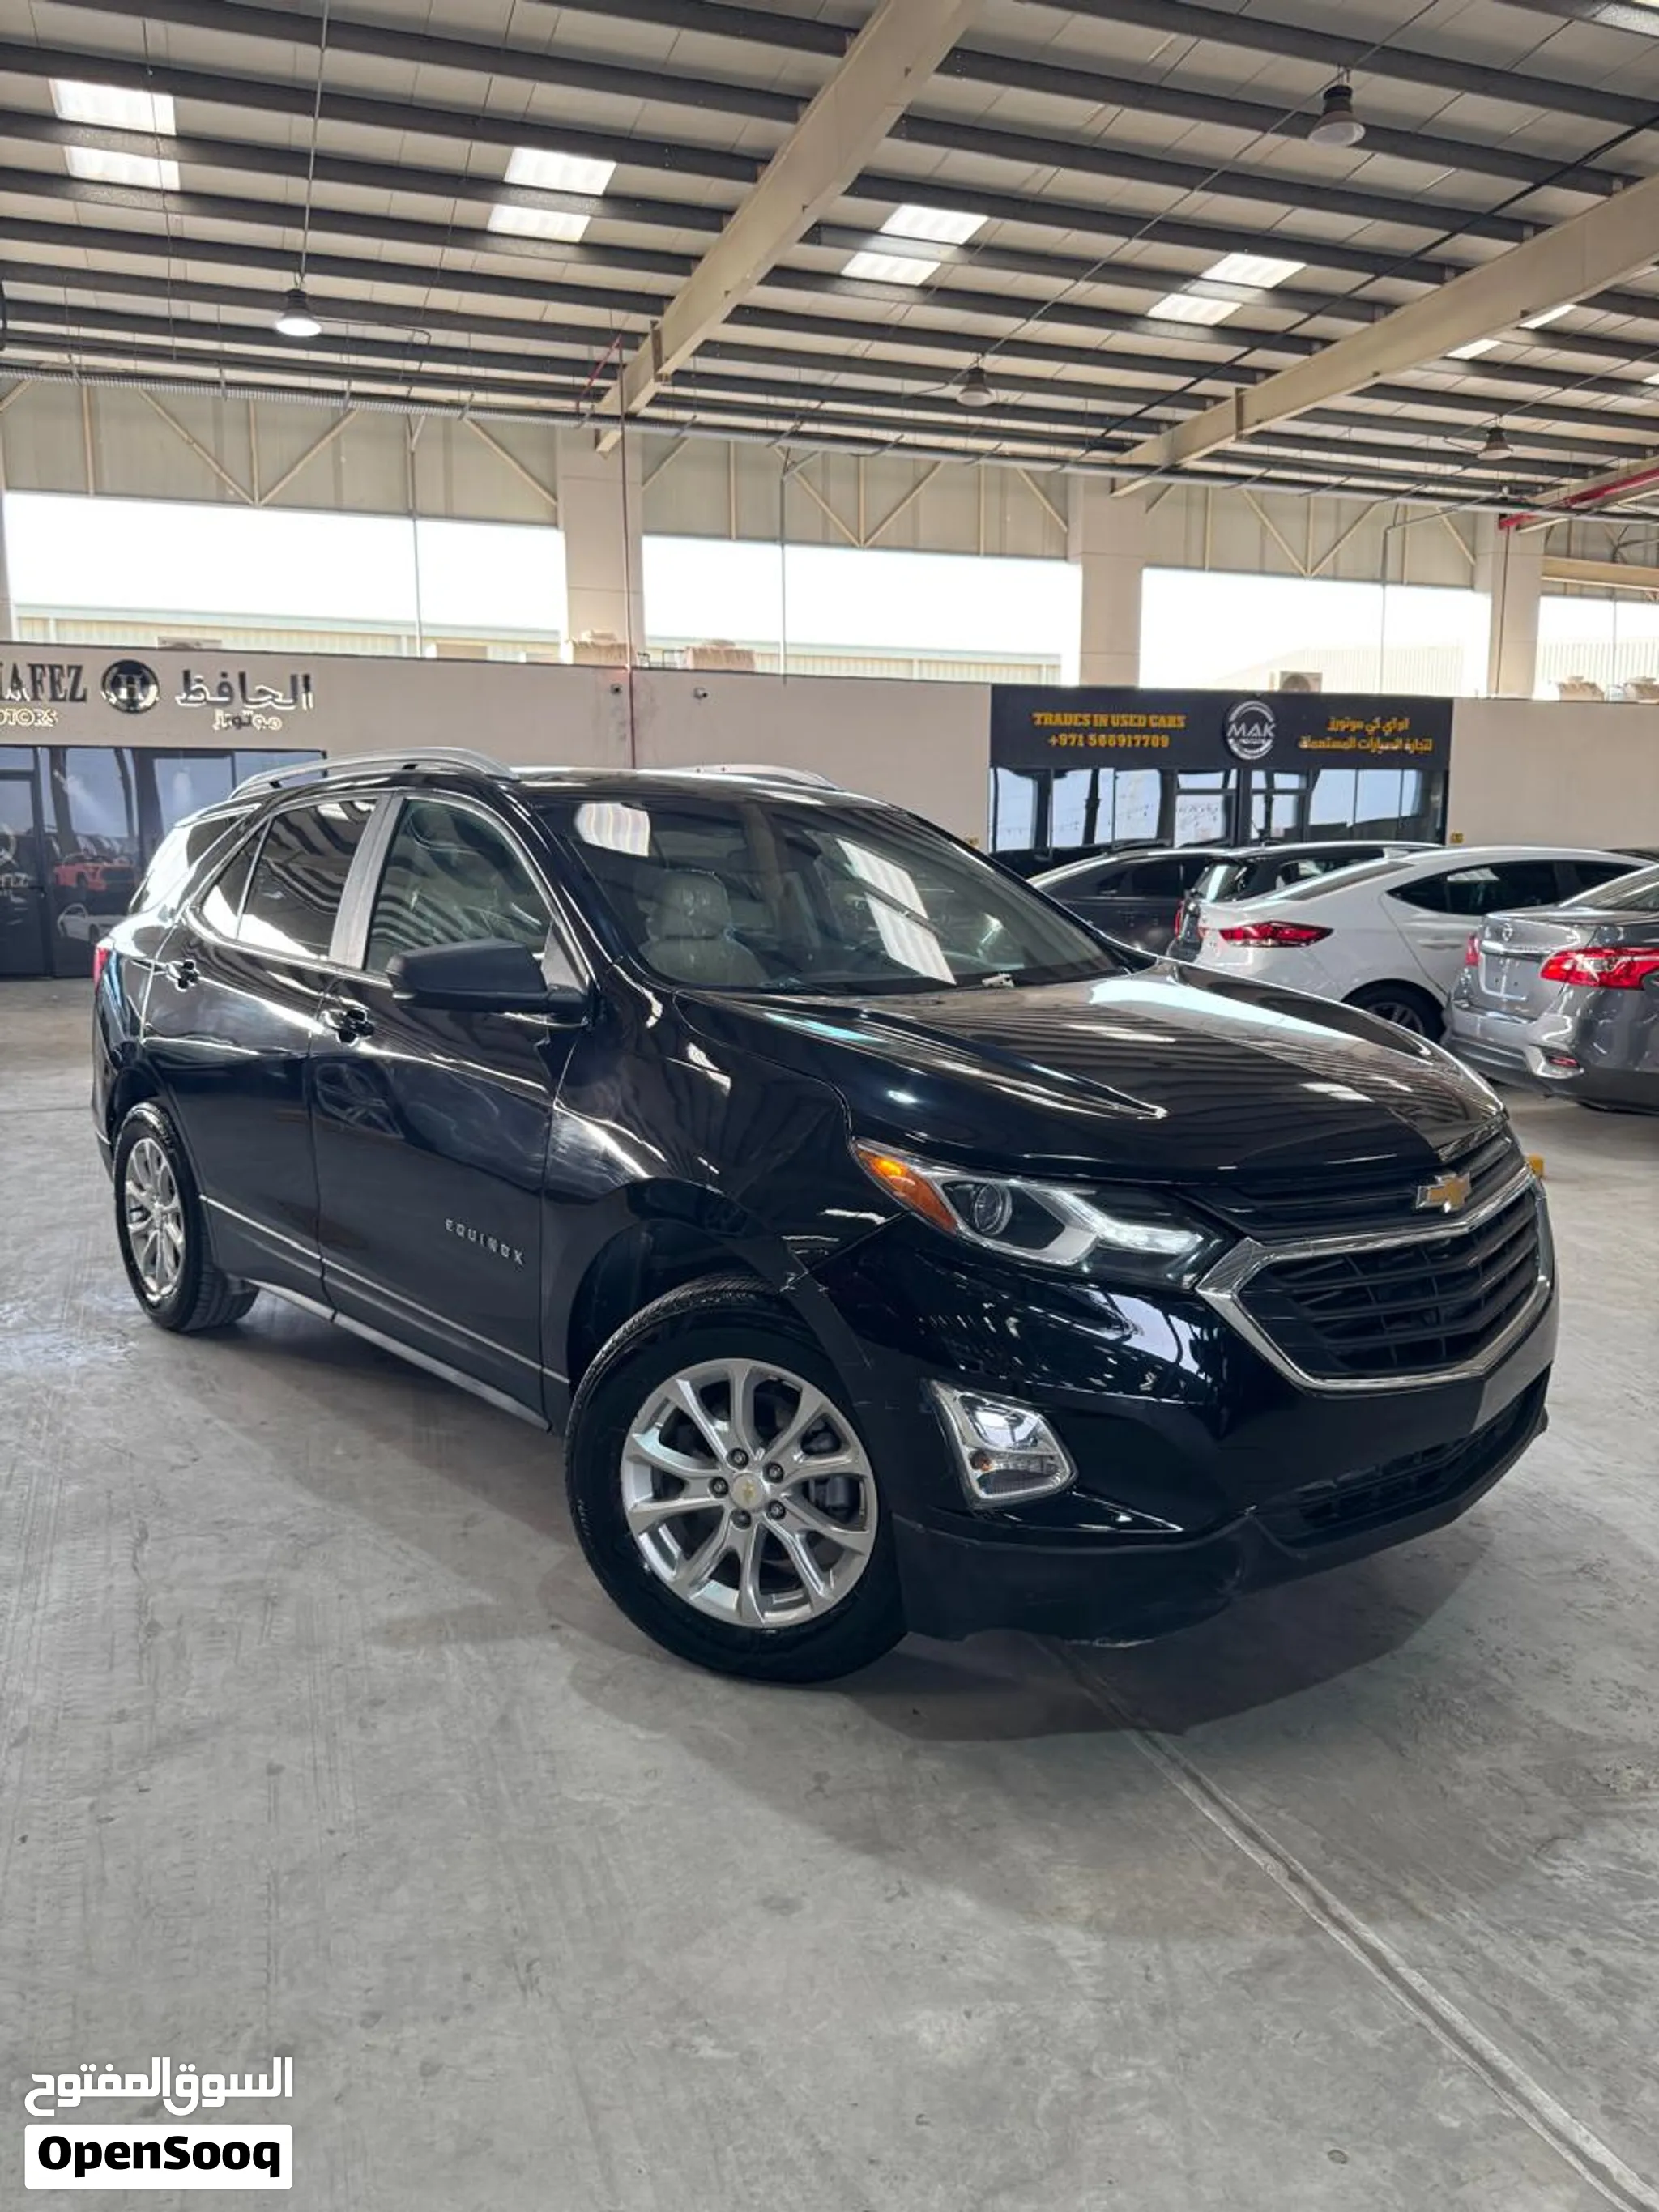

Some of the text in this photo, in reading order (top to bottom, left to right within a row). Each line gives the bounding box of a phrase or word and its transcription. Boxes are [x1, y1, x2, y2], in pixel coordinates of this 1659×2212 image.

[0, 661, 87, 703] AFEZ
[175, 669, 313, 710] الحافظ
[1031, 712, 1187, 729] TRADES IN USED CARS
[1226, 722, 1277, 738] MAK
[1048, 732, 1085, 748] +971
[1358, 736, 1403, 755] السيارات
